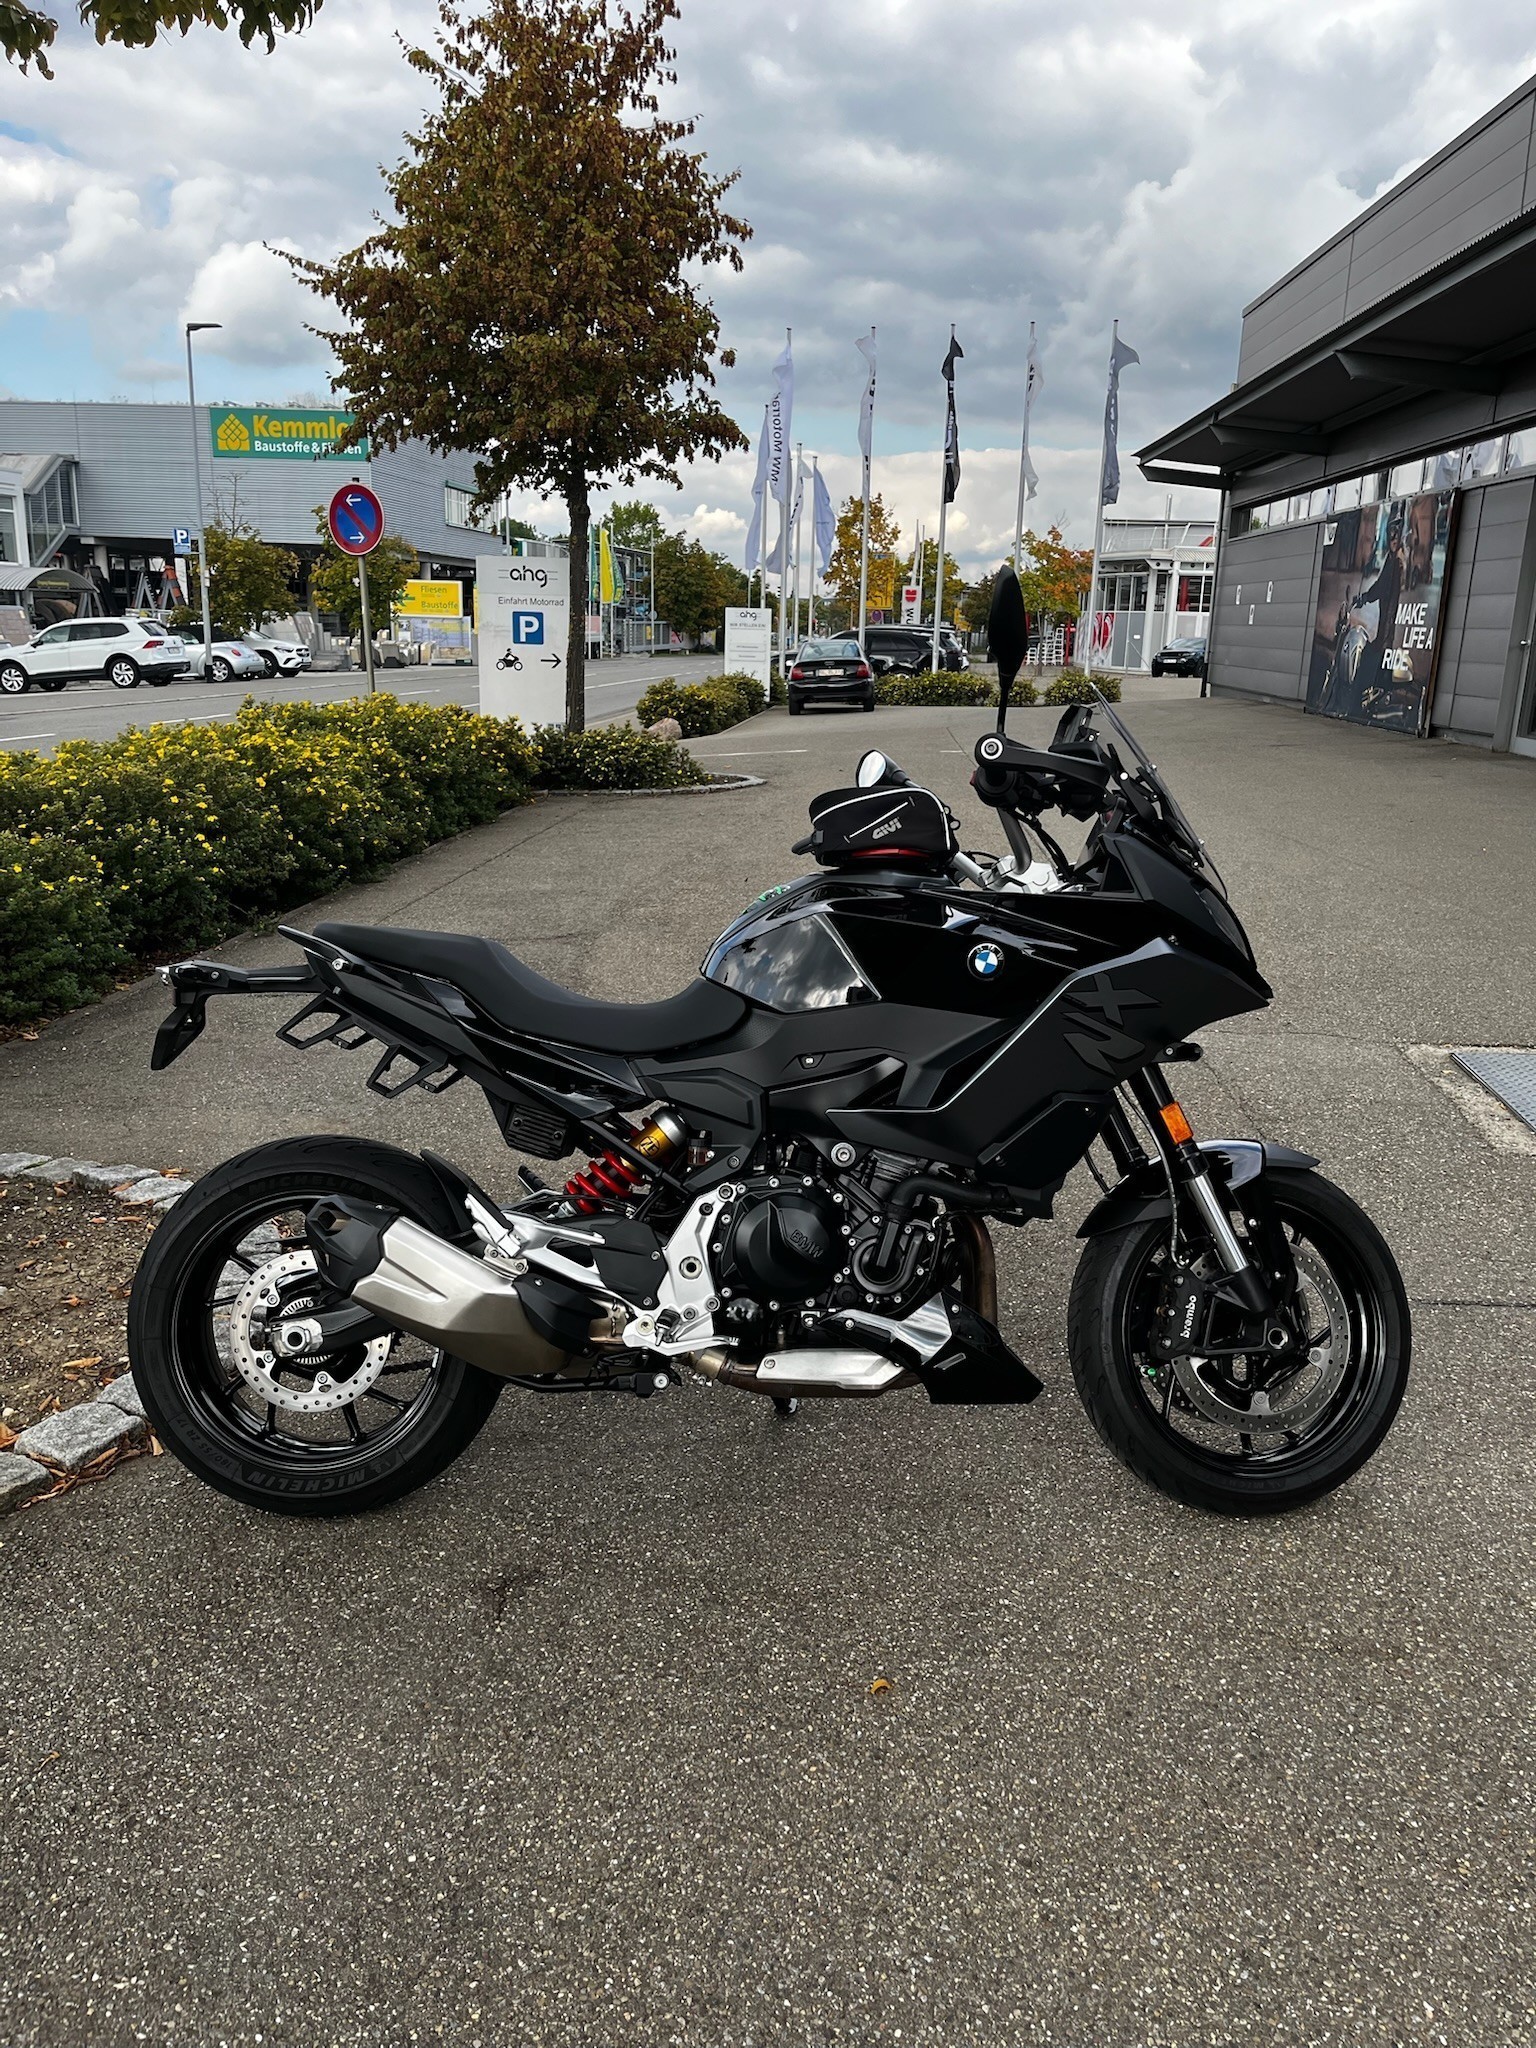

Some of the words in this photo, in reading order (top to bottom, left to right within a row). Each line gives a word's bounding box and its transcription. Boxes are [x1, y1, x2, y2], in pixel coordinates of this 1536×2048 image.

[254, 440, 312, 454] Baustoffe
[311, 442, 321, 453] &
[177, 529, 188, 544] P
[509, 565, 548, 588] ahg
[420, 585, 448, 594] Fliesen
[421, 601, 460, 610] Baustoffe
[498, 596, 528, 606] Einfahrt
[529, 597, 565, 607] Motorrad
[1394, 602, 1429, 625] MAKE
[519, 615, 540, 643] P
[1402, 626, 1428, 650] LIFE
[1424, 627, 1434, 650] A
[872, 816, 903, 840] GIVI
[790, 1229, 824, 1259] BMW
[1180, 1294, 1197, 1339] brembo
[245, 1466, 367, 1493] MICHELIN
